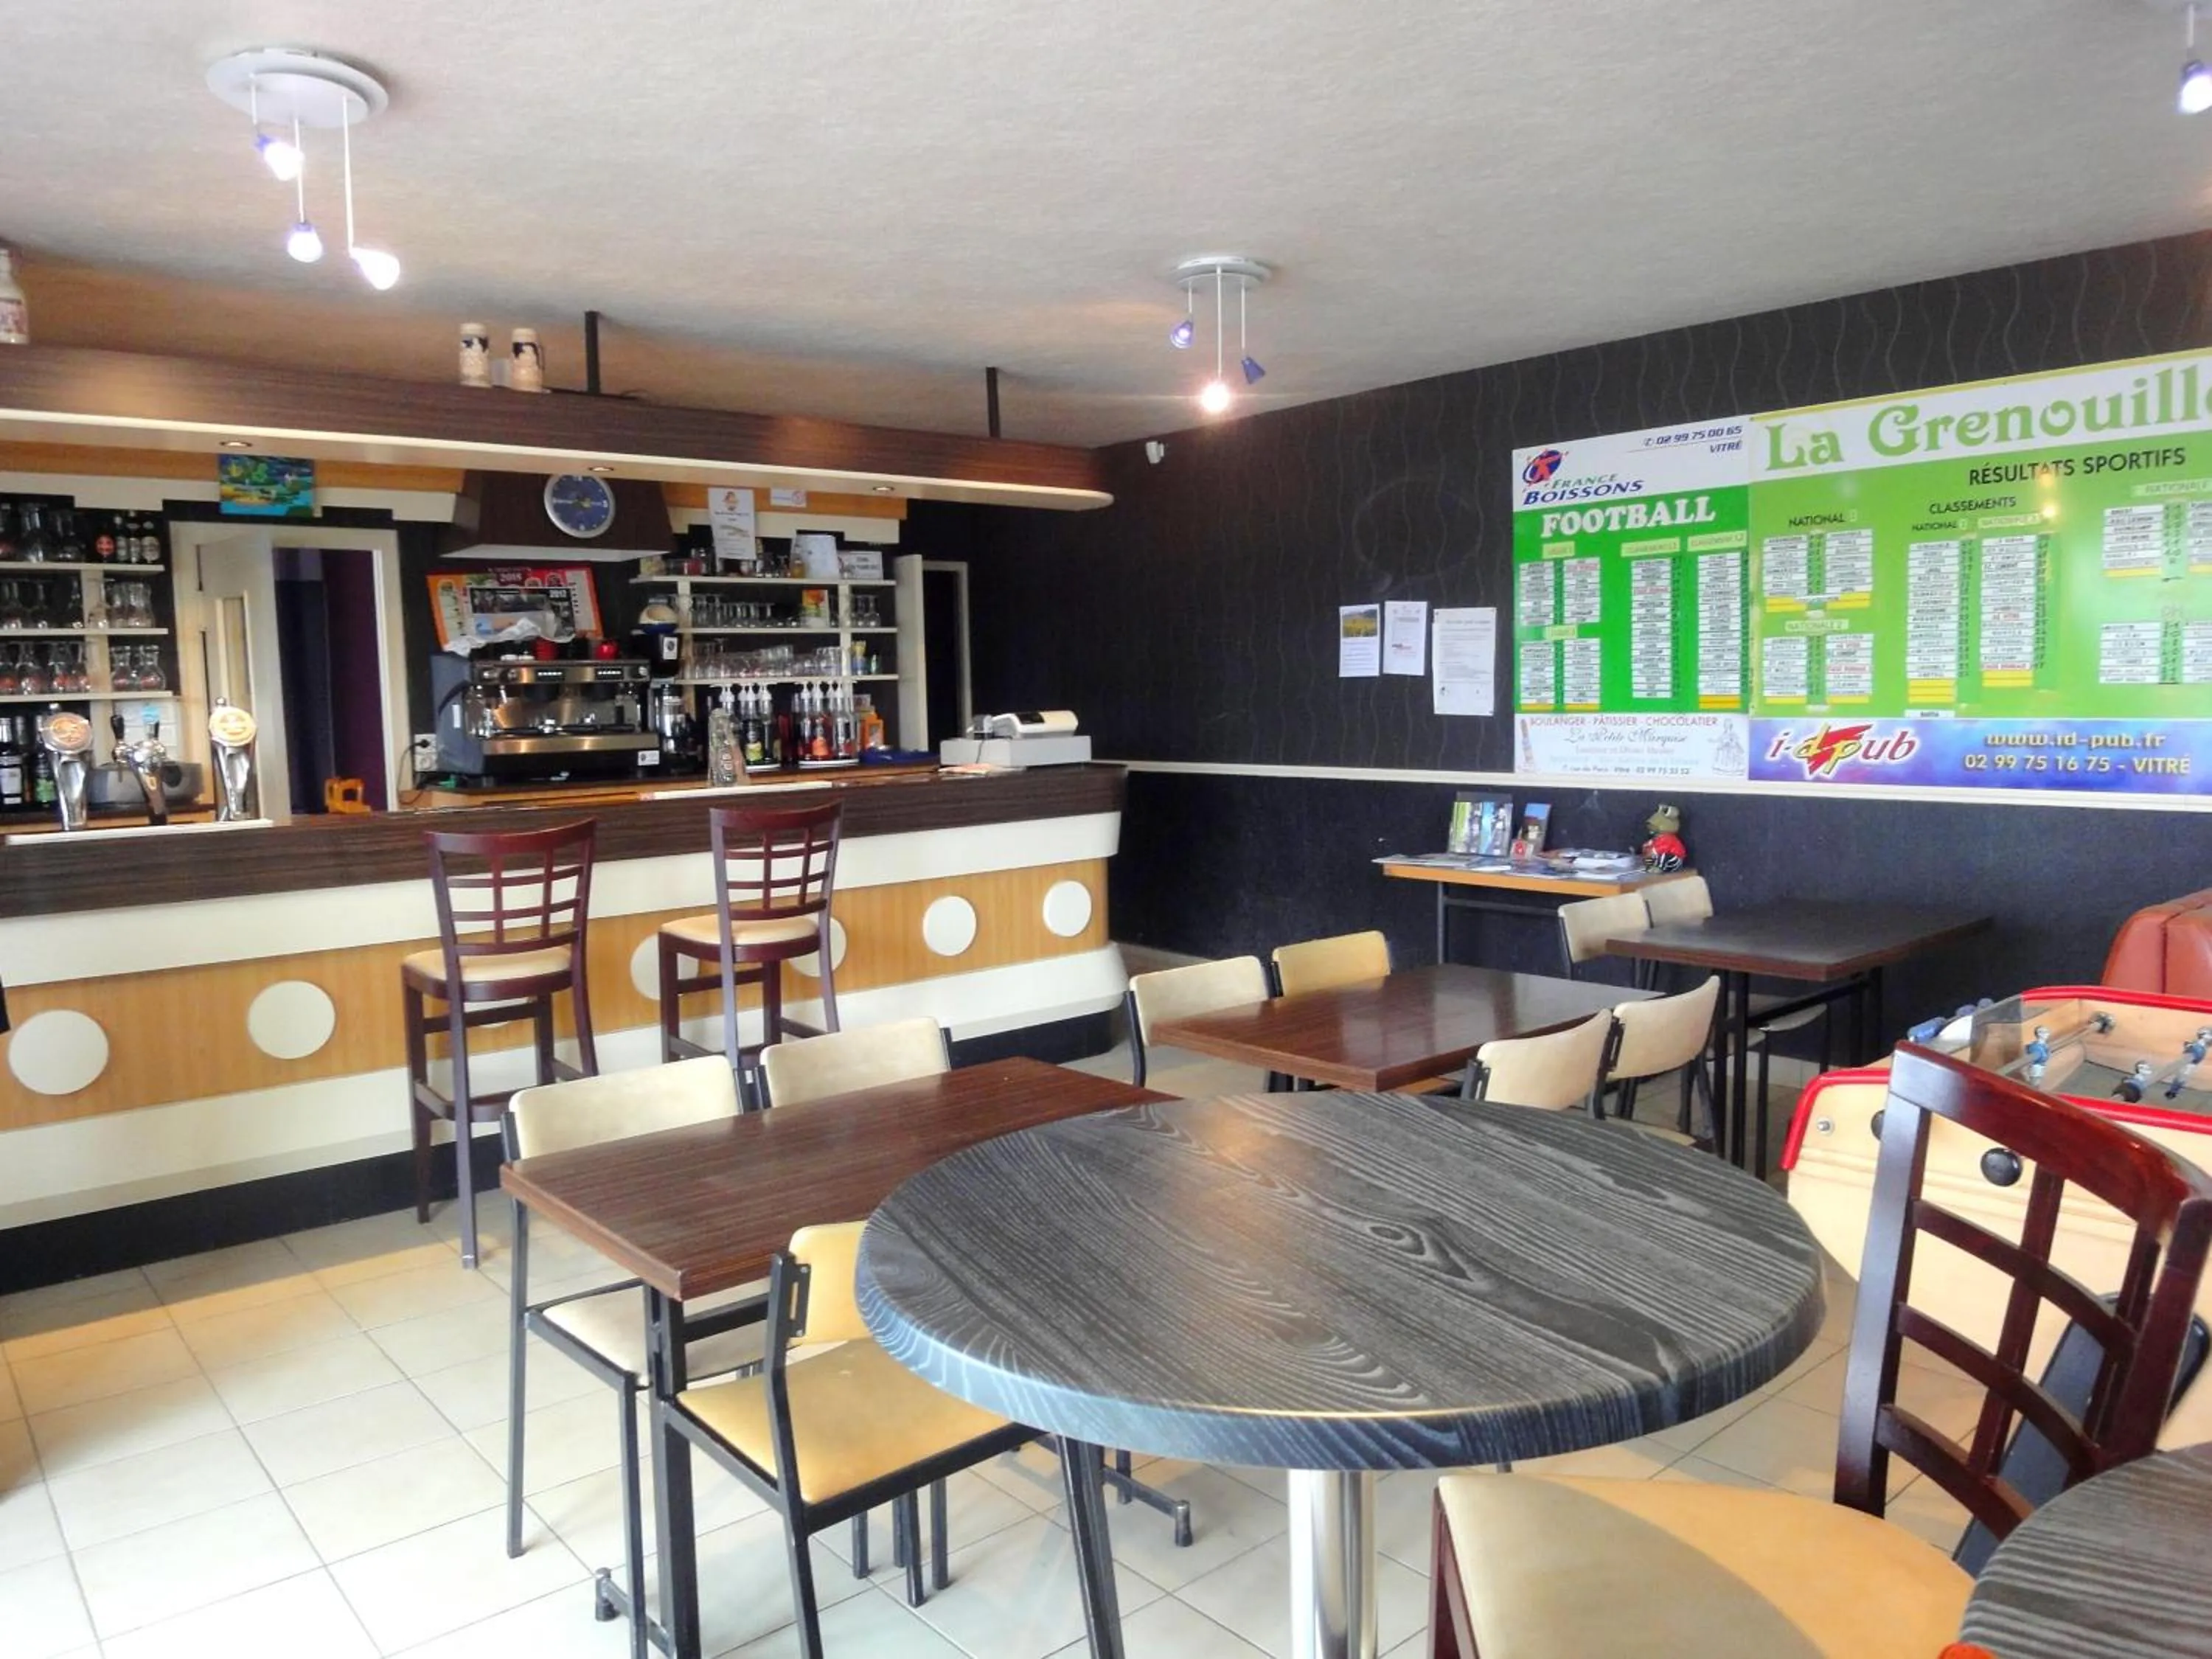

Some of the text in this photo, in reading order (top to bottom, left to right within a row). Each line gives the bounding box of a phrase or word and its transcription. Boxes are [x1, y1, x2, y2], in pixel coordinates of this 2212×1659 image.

[1656, 435, 1672, 445] 02
[1674, 433, 1689, 442] 99
[1691, 430, 1705, 440] 75
[1708, 428, 1724, 438] 00
[1765, 422, 1845, 471] La
[1969, 448, 2187, 487] RÉSULTATS SPORTIFS
[1553, 473, 1617, 489] FRANCE
[1523, 480, 1644, 505] BOISSONS
[1929, 496, 2017, 515] CLASSEMENTS
[1541, 496, 1716, 538] FOOTBALL
[1789, 513, 1846, 528] NATIONAL
[1912, 521, 1957, 531] NATIONAL
[1646, 716, 1718, 726] CHOCOLATIER
[1985, 731, 2166, 749] www.id-pub.fr
[1964, 754, 1987, 769] 02
[1994, 754, 2017, 770] 99
[2023, 754, 2047, 771] 75
[2058, 755, 2078, 771] 16
[2087, 756, 2110, 772] 75
[2132, 754, 2191, 775] VITRÉ
